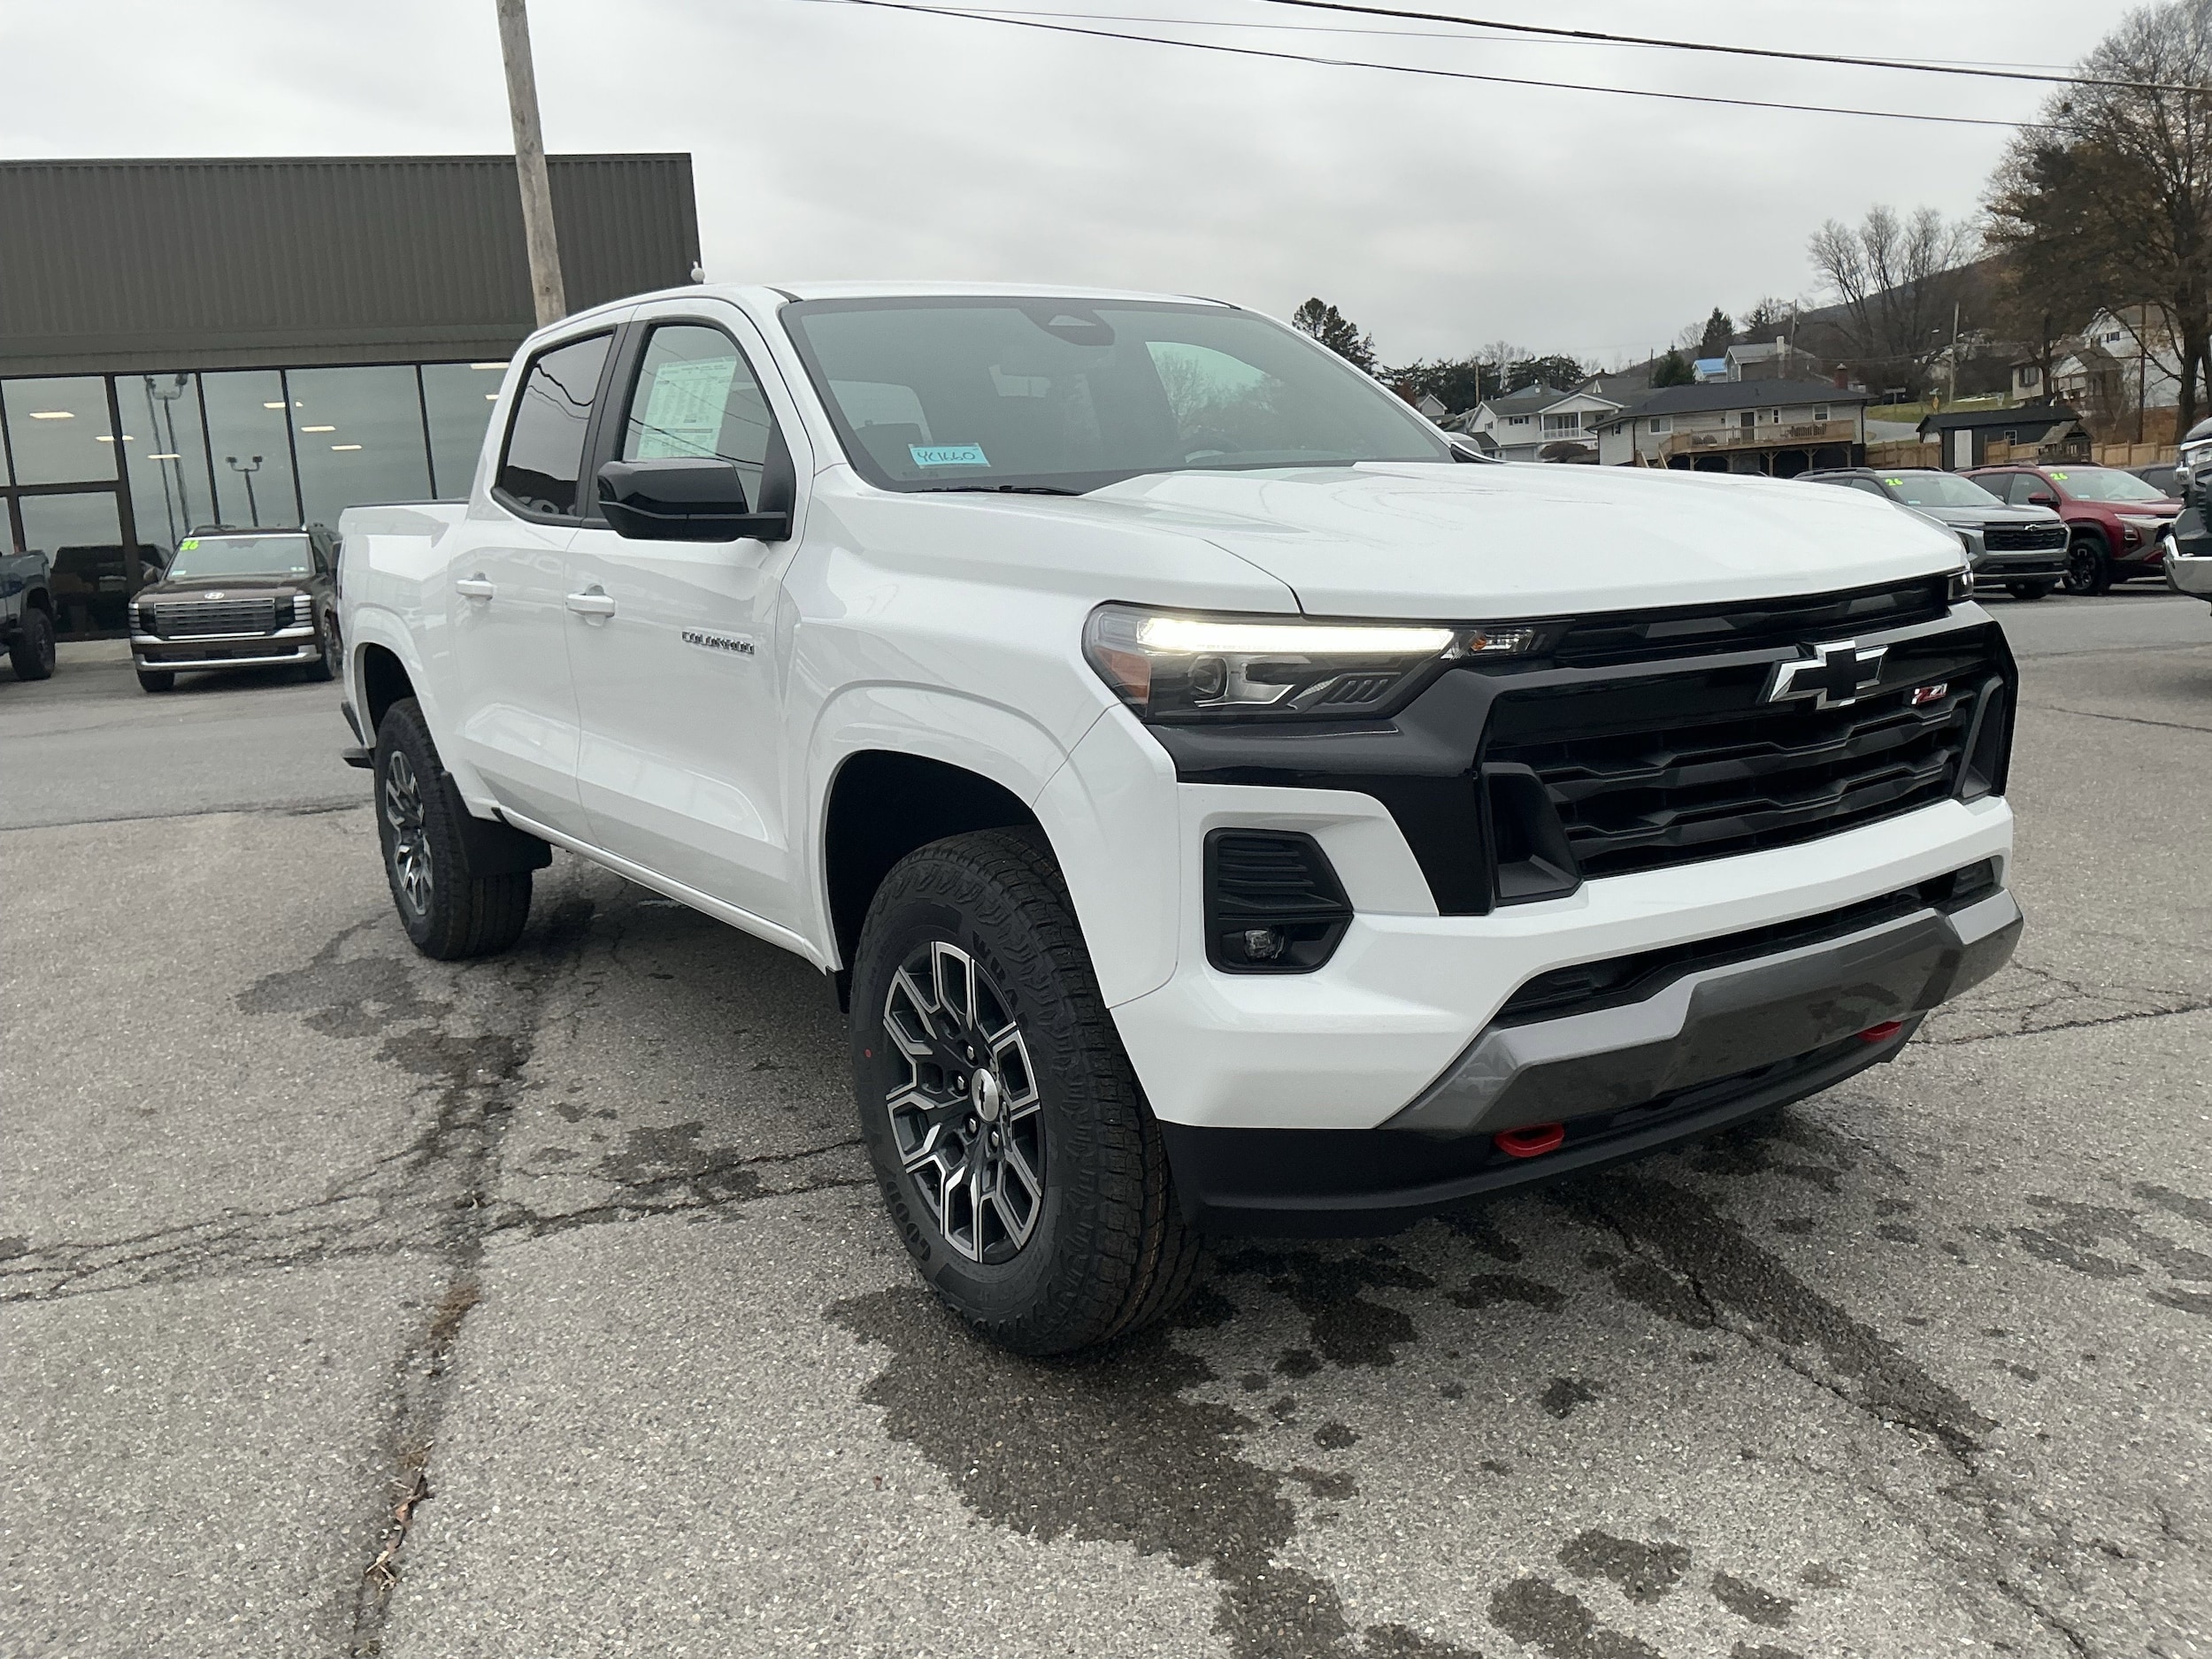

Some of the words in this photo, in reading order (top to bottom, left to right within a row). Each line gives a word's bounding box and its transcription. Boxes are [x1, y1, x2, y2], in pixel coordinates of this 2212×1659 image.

[1885, 478, 1903, 487] 26
[180, 540, 199, 551] 26
[1911, 682, 1948, 705] Z71
